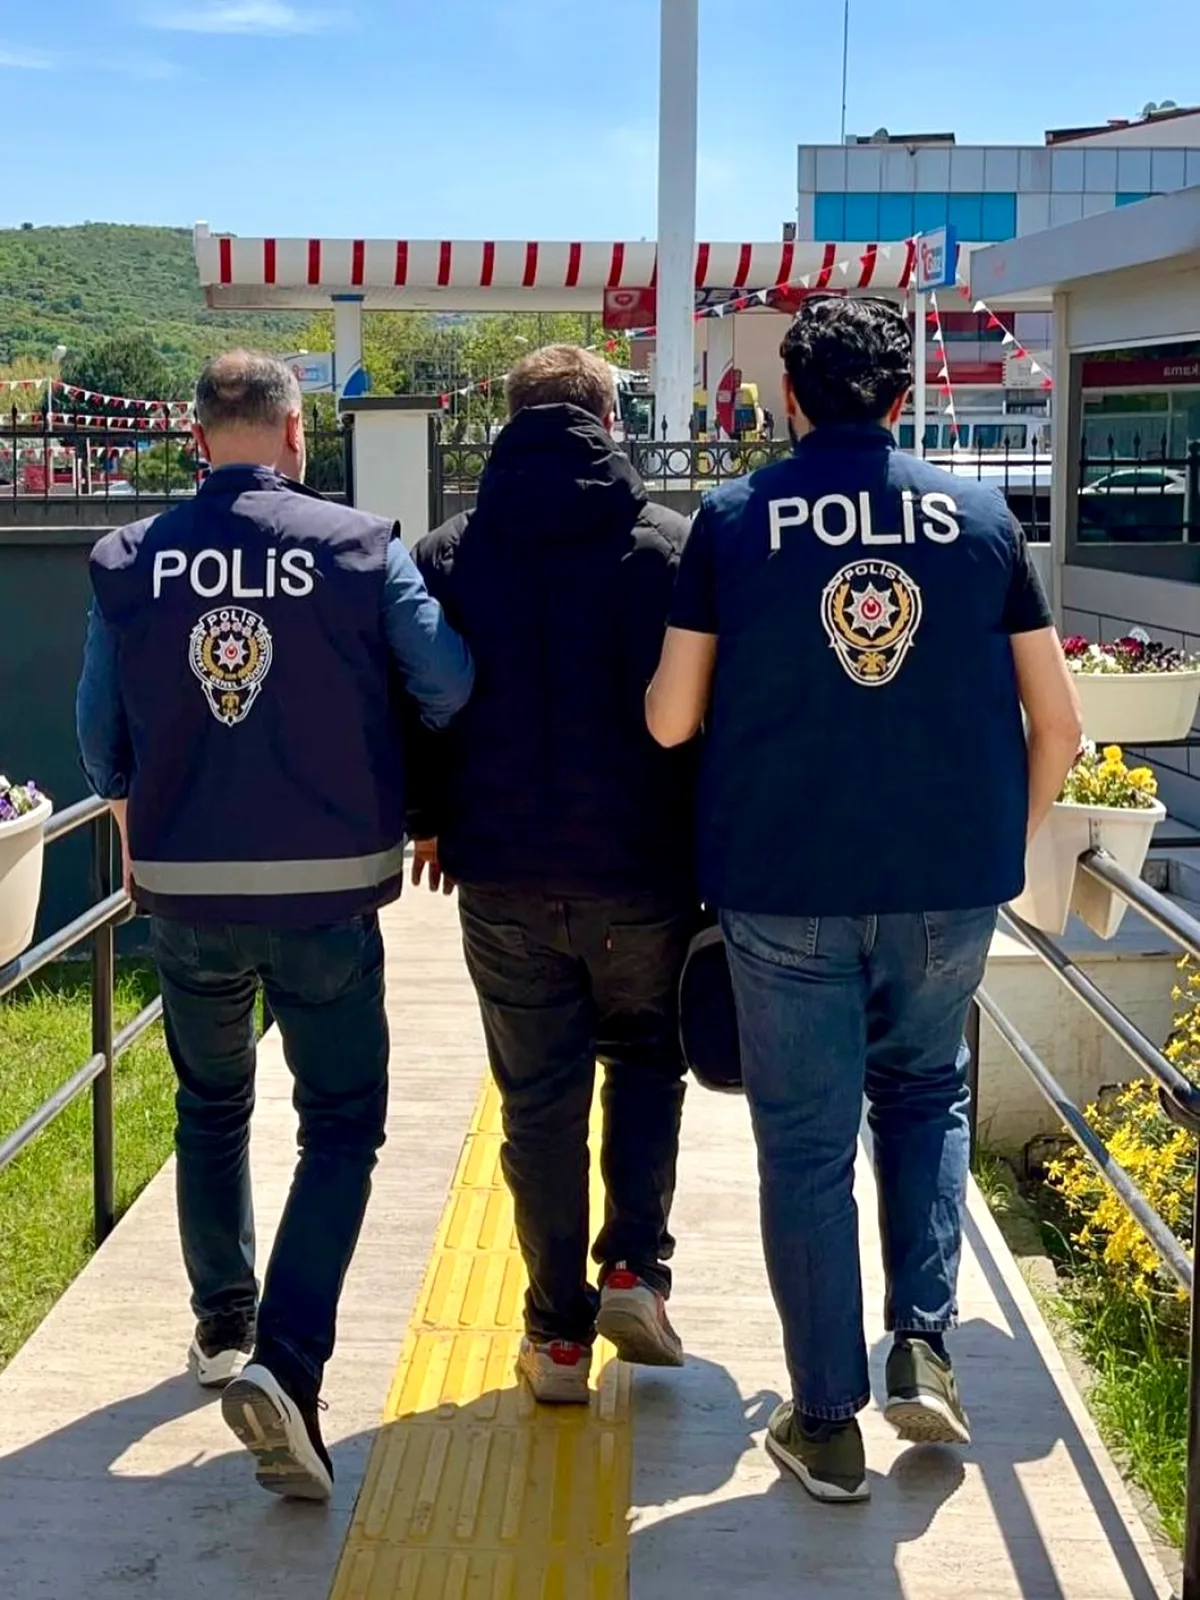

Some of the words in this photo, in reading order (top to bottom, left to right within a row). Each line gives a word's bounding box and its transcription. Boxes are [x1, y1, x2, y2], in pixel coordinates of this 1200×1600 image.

[768, 491, 961, 550] POLİS
[153, 548, 315, 598] POLİS
[844, 564, 897, 580] POLİS
[207, 609, 257, 627] POLİS
